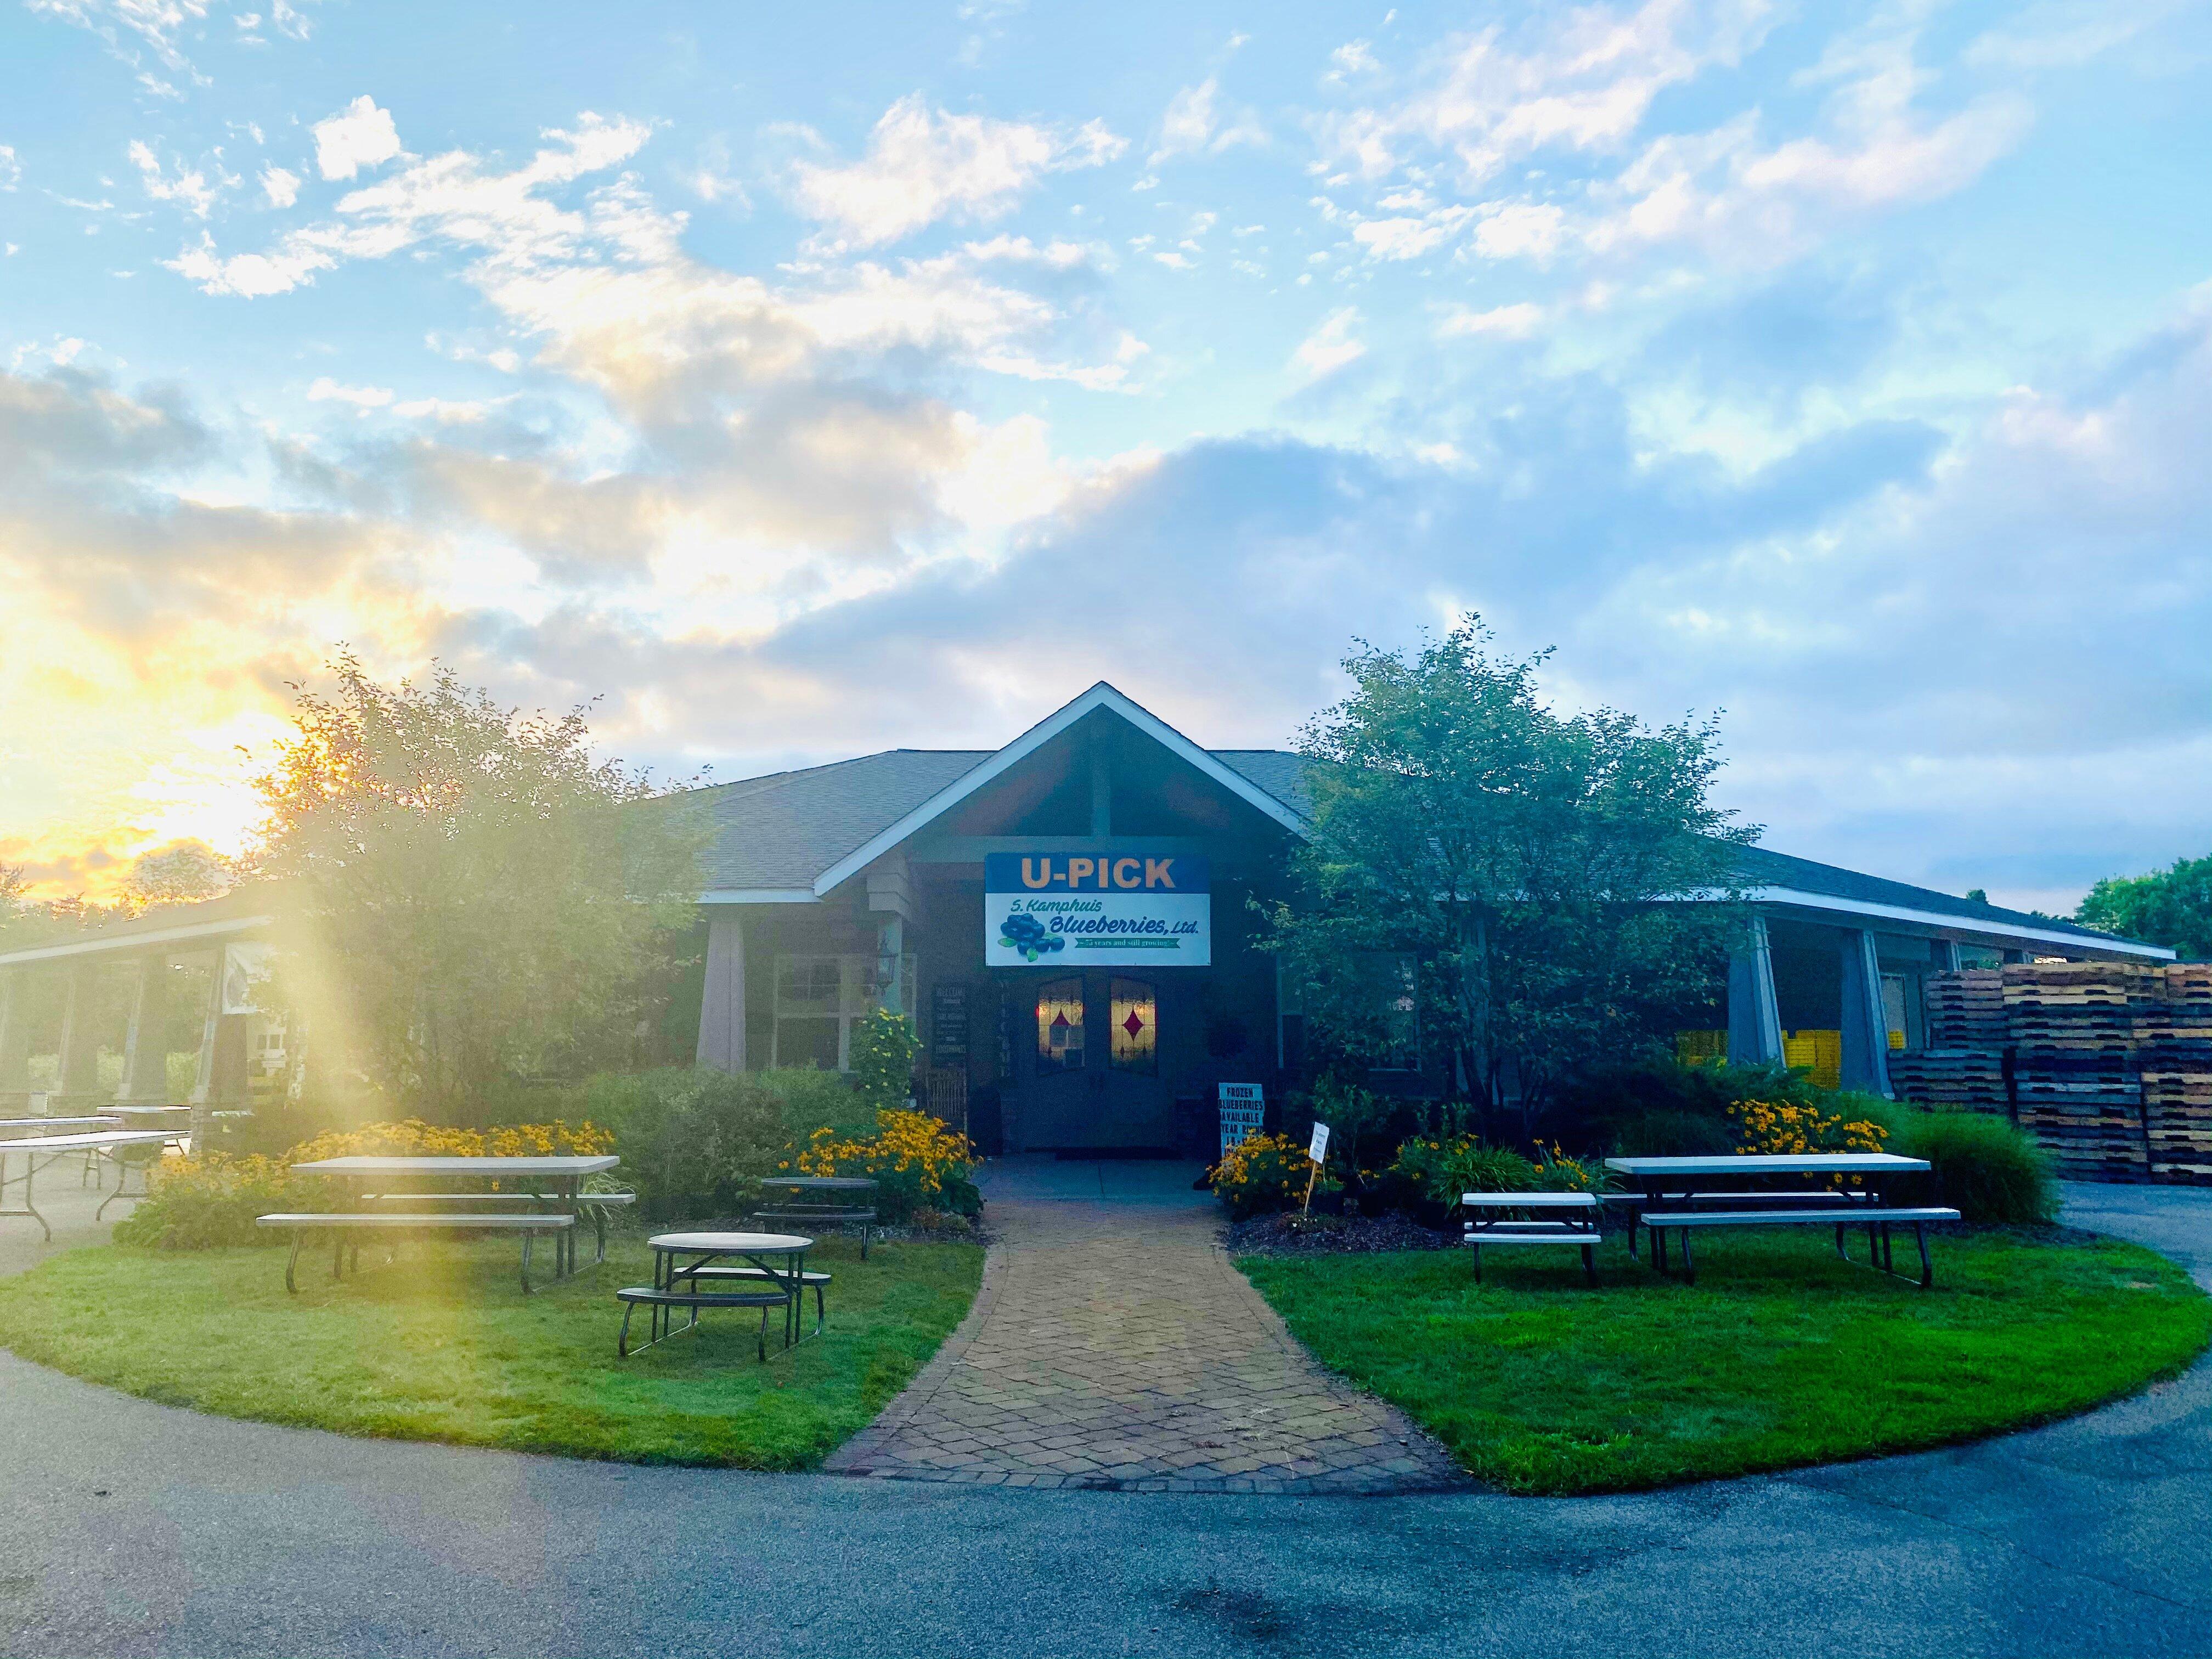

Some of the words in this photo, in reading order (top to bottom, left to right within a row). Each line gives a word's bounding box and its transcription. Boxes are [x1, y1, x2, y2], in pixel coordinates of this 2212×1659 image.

[1022, 857, 1176, 888] U-PICK
[1010, 899, 1024, 912] S.
[1026, 898, 1102, 915] Kamphuis
[1049, 915, 1169, 936] Blueberries,
[1170, 920, 1199, 934] Ltd.
[1226, 1087, 1254, 1097] FROZEN
[1218, 1099, 1263, 1110] BLUEBERRIES
[1221, 1112, 1260, 1123] AVAILABLE
[1221, 1123, 1238, 1134] YEAR
